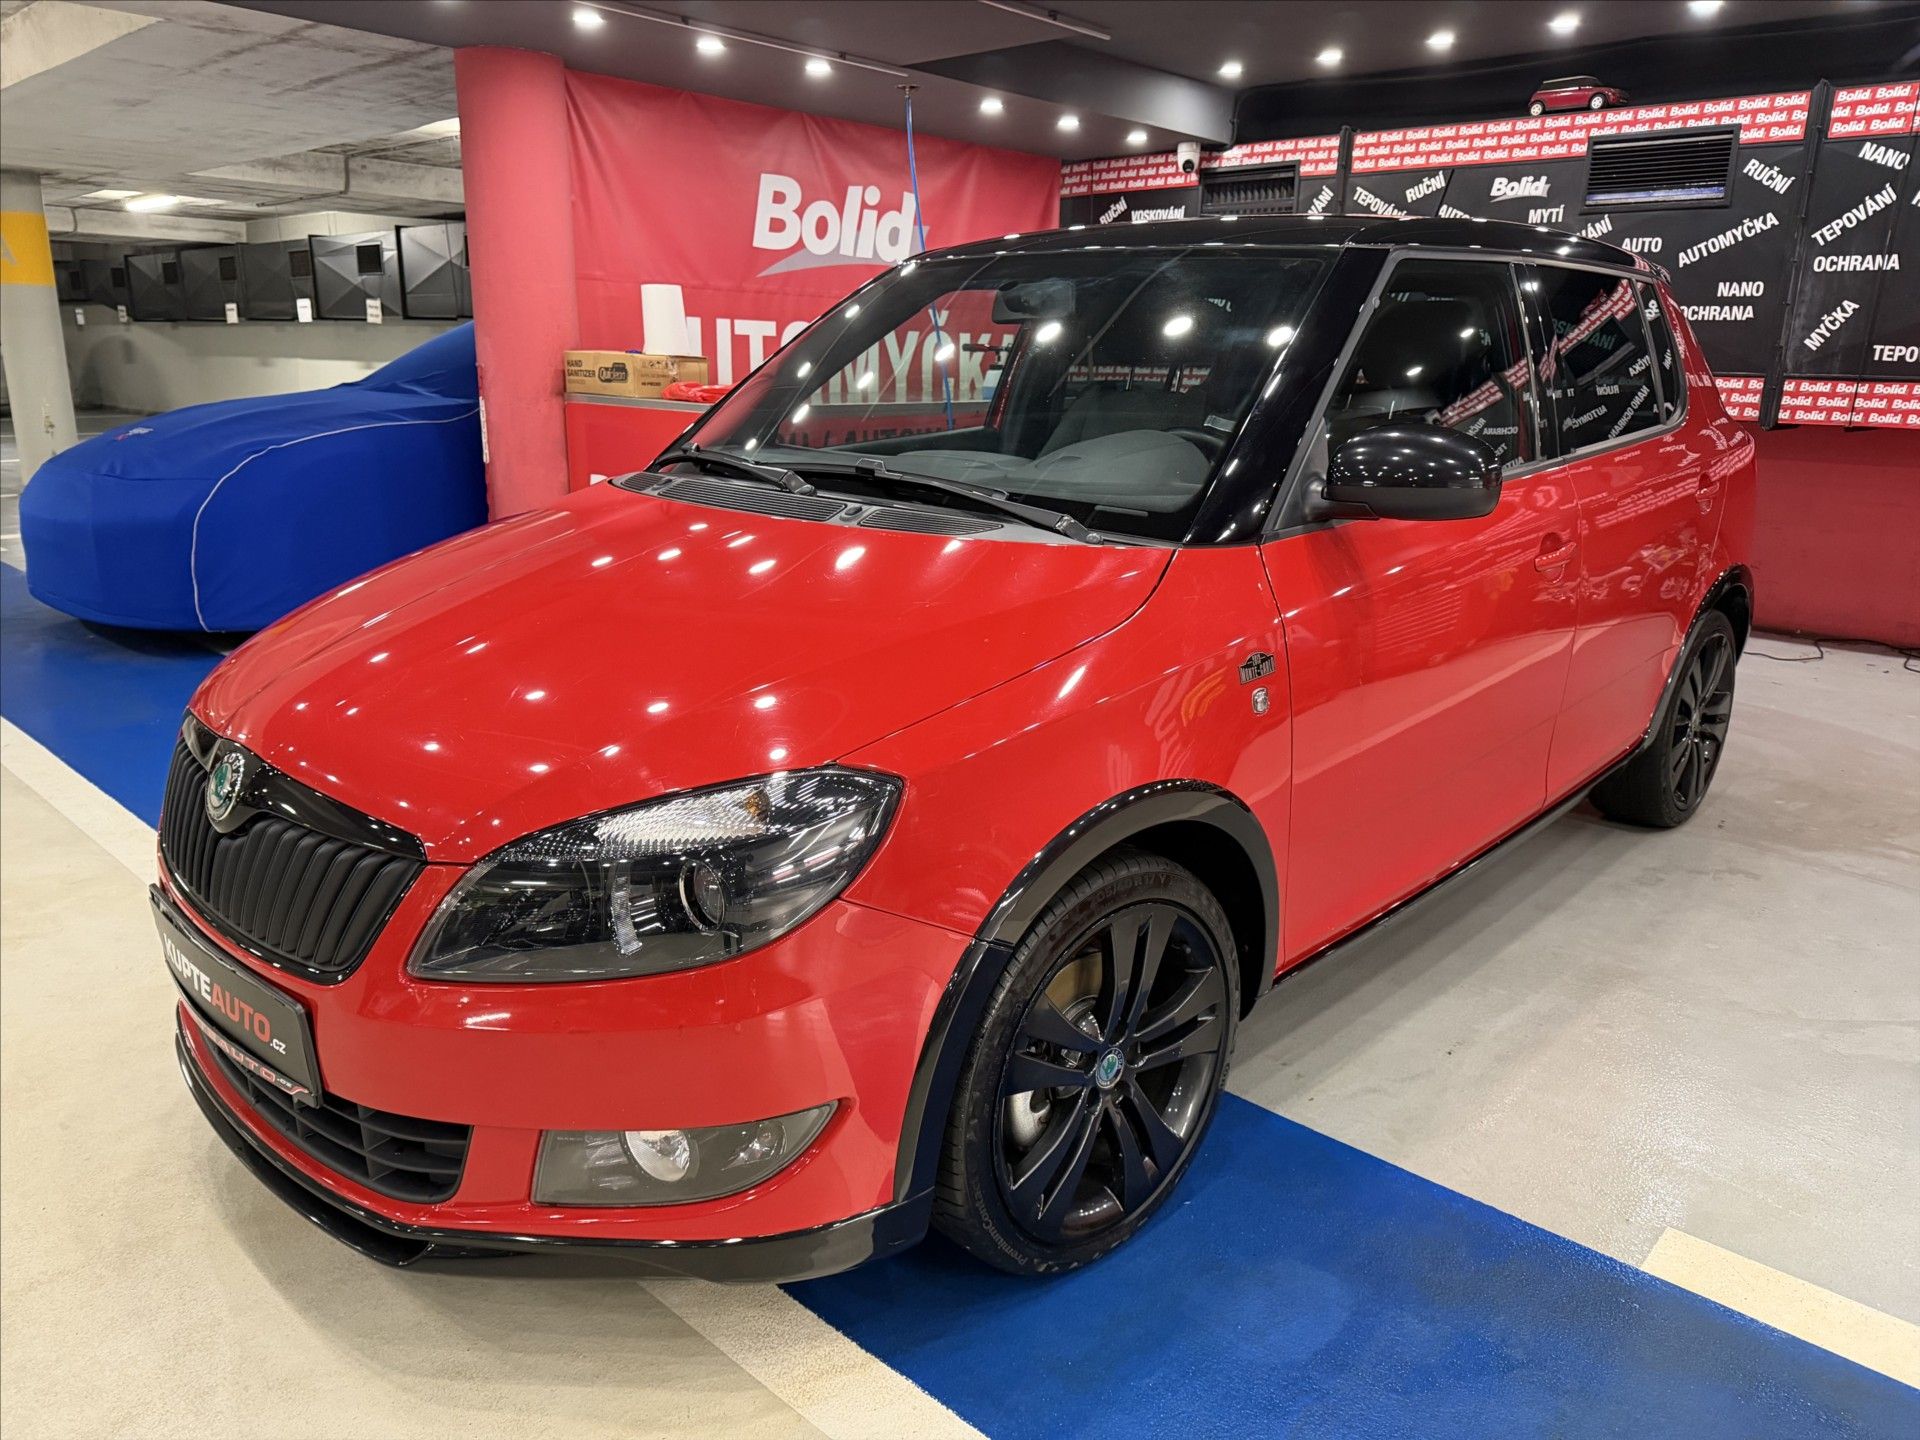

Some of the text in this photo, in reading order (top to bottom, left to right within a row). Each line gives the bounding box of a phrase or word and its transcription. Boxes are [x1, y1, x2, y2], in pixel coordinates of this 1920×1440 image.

[1837, 86, 1911, 102] Bolid Bolid
[1831, 106, 1851, 118] lid
[1856, 103, 1890, 116] Bolid
[1832, 120, 1865, 133] Bolid
[1870, 117, 1905, 130] Bolid
[1858, 141, 1910, 170] NANO
[1743, 158, 1796, 195] RUČNÍ
[1405, 170, 1446, 203] RUČNÍ
[1489, 175, 1548, 200] Bolid
[753, 172, 917, 262] Bolid
[1100, 196, 1128, 225] RUČNÍ
[1131, 205, 1185, 221] VOSKOVÁNÍ
[1529, 204, 1565, 223] MYTÍ
[1811, 182, 1897, 246] TEPOVÁNÍ
[1621, 237, 1662, 253] AUTO
[1678, 211, 1780, 268] AUTOMYČKA
[1813, 254, 1900, 272] OCHRANA
[1717, 281, 1764, 297] NANO
[1803, 299, 1860, 351] MYČKA
[1800, 382, 1832, 392] Bolid
[1836, 382, 1868, 394] Bolid
[1874, 384, 1908, 394] Bolid
[1730, 392, 1760, 404] Bolid
[1781, 396, 1812, 406] Bolid
[1816, 397, 1849, 407] Bolid
[1854, 398, 1887, 409] Bolid
[1795, 410, 1826, 421] Bolid
[1830, 412, 1863, 422] Bolid
[1868, 413, 1902, 424] Bolid
